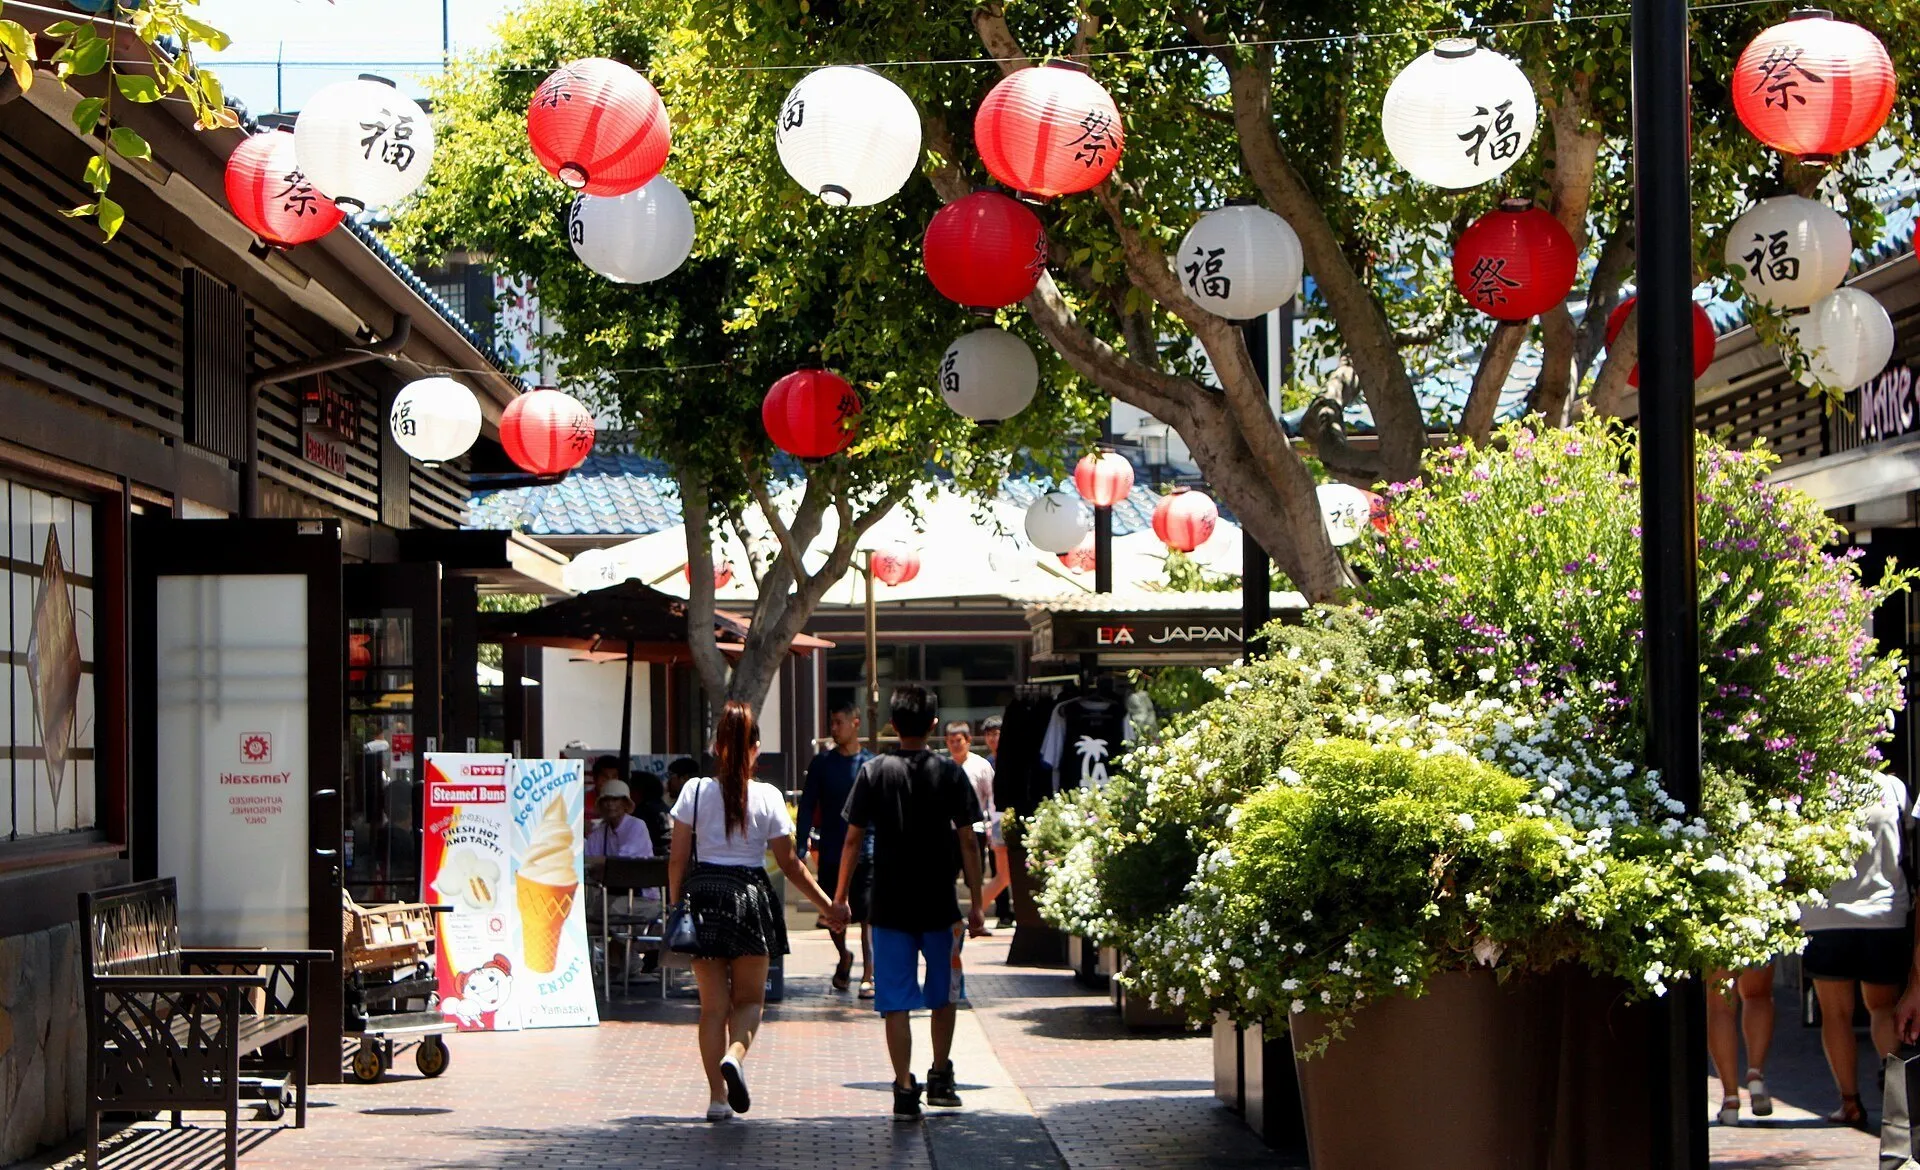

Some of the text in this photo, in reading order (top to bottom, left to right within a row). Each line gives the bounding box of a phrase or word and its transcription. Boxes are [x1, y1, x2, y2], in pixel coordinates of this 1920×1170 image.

[1751, 45, 1824, 111] 祭
[359, 108, 415, 172] 福
[1064, 108, 1117, 168] 祭
[1457, 99, 1521, 166] 福
[273, 166, 317, 217] 祭
[1184, 246, 1231, 299] 福
[1742, 230, 1799, 285] 福
[1468, 256, 1522, 306] 祭
[938, 350, 960, 393] 福
[391, 399, 416, 438] 福
[568, 414, 594, 452] 祭
[1148, 626, 1243, 643] JAPAN
[433, 786, 506, 802] Steamed Buns
[514, 761, 553, 800] COLD
[514, 771, 577, 827] Ice Cream
[442, 826, 499, 841] FRESH HOT
[446, 836, 467, 848] AND
[538, 956, 584, 995] ENJOY!
